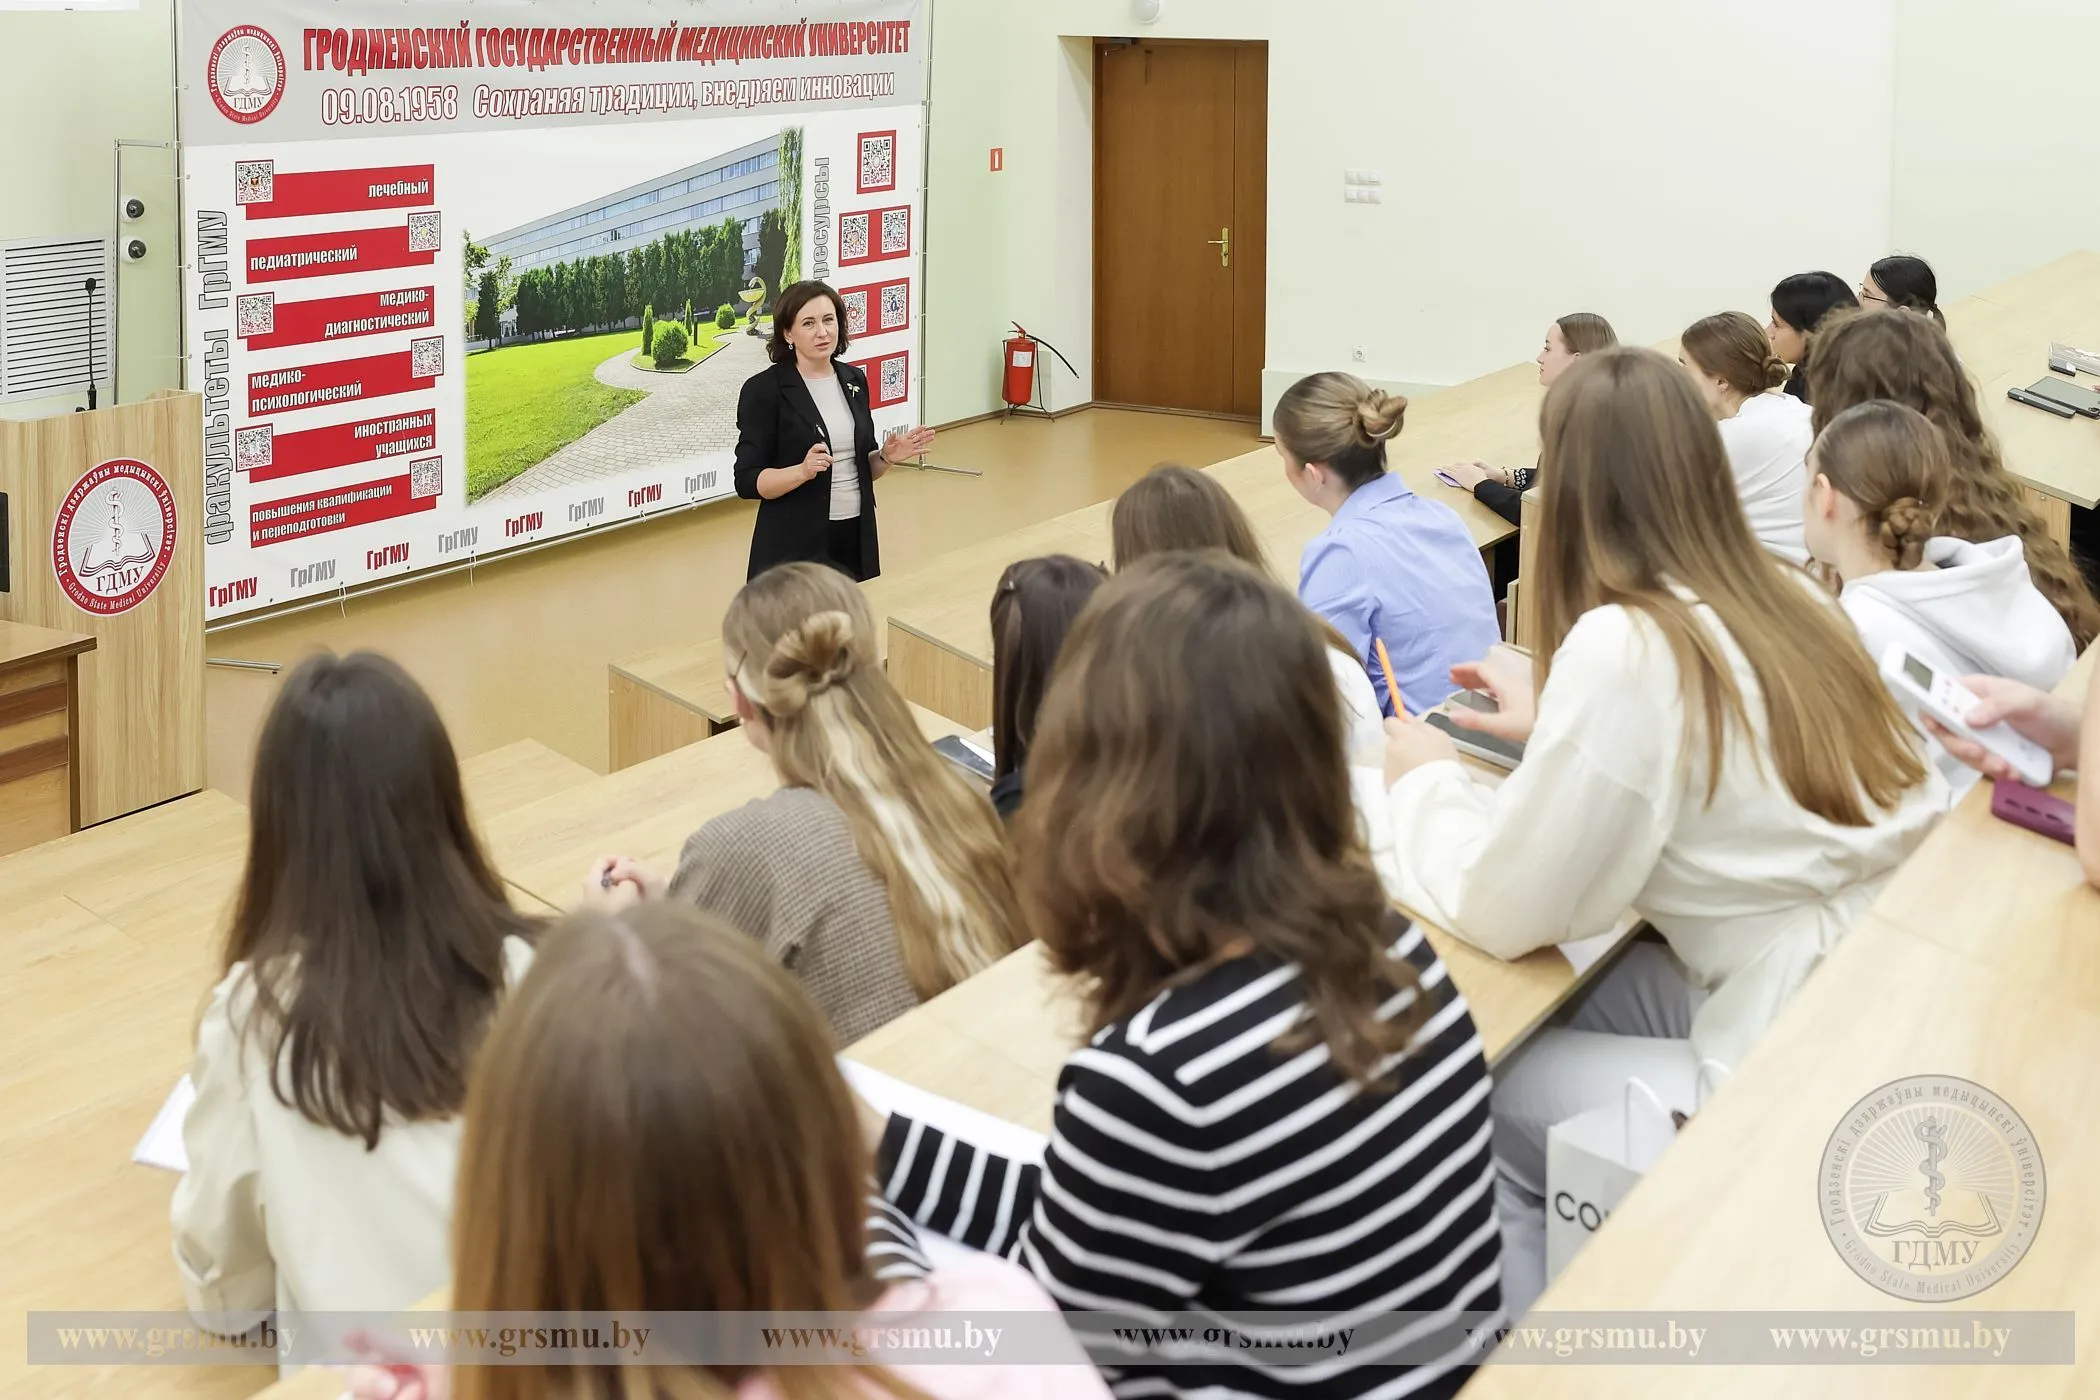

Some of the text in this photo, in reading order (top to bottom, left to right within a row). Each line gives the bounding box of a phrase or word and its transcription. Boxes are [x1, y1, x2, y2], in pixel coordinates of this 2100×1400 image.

[303, 18, 911, 76] ГРОДНЕНСКИЙ ГОСУДАРСТВЕННЫЙ МЕДИЦИНСКИЙ УНИВЕРСИТЕТ
[322, 85, 458, 125] 09.08.1958
[472, 72, 895, 120] Сохраняя традиции, внедряем инновации
[368, 178, 429, 198] лечебный
[813, 157, 831, 280] ресурсы
[198, 210, 231, 310] ГрГМУ
[250, 244, 358, 271] педиатрический
[380, 289, 429, 307] медико-
[324, 309, 430, 338] диагностический
[251, 369, 306, 389] медико-
[252, 381, 362, 412] психологический
[203, 329, 234, 545] факультеты
[354, 413, 433, 439] иностранных
[375, 435, 433, 459] учащихся
[628, 483, 662, 508] ГрГМУ
[685, 470, 717, 494] ГрГМУ
[252, 484, 393, 523] повышения квалификации
[568, 497, 604, 522] ГрГМУ
[252, 512, 346, 541] и переподготовки
[505, 511, 543, 537] ГрГМУ
[438, 526, 478, 554] ГрГМУ
[366, 542, 409, 570] ГрГМУ
[96, 565, 145, 595] ГДМУ
[290, 559, 336, 588] ГрГМУ
[209, 576, 258, 607] ГрГМУ
[1555, 1190, 1609, 1232] CO
